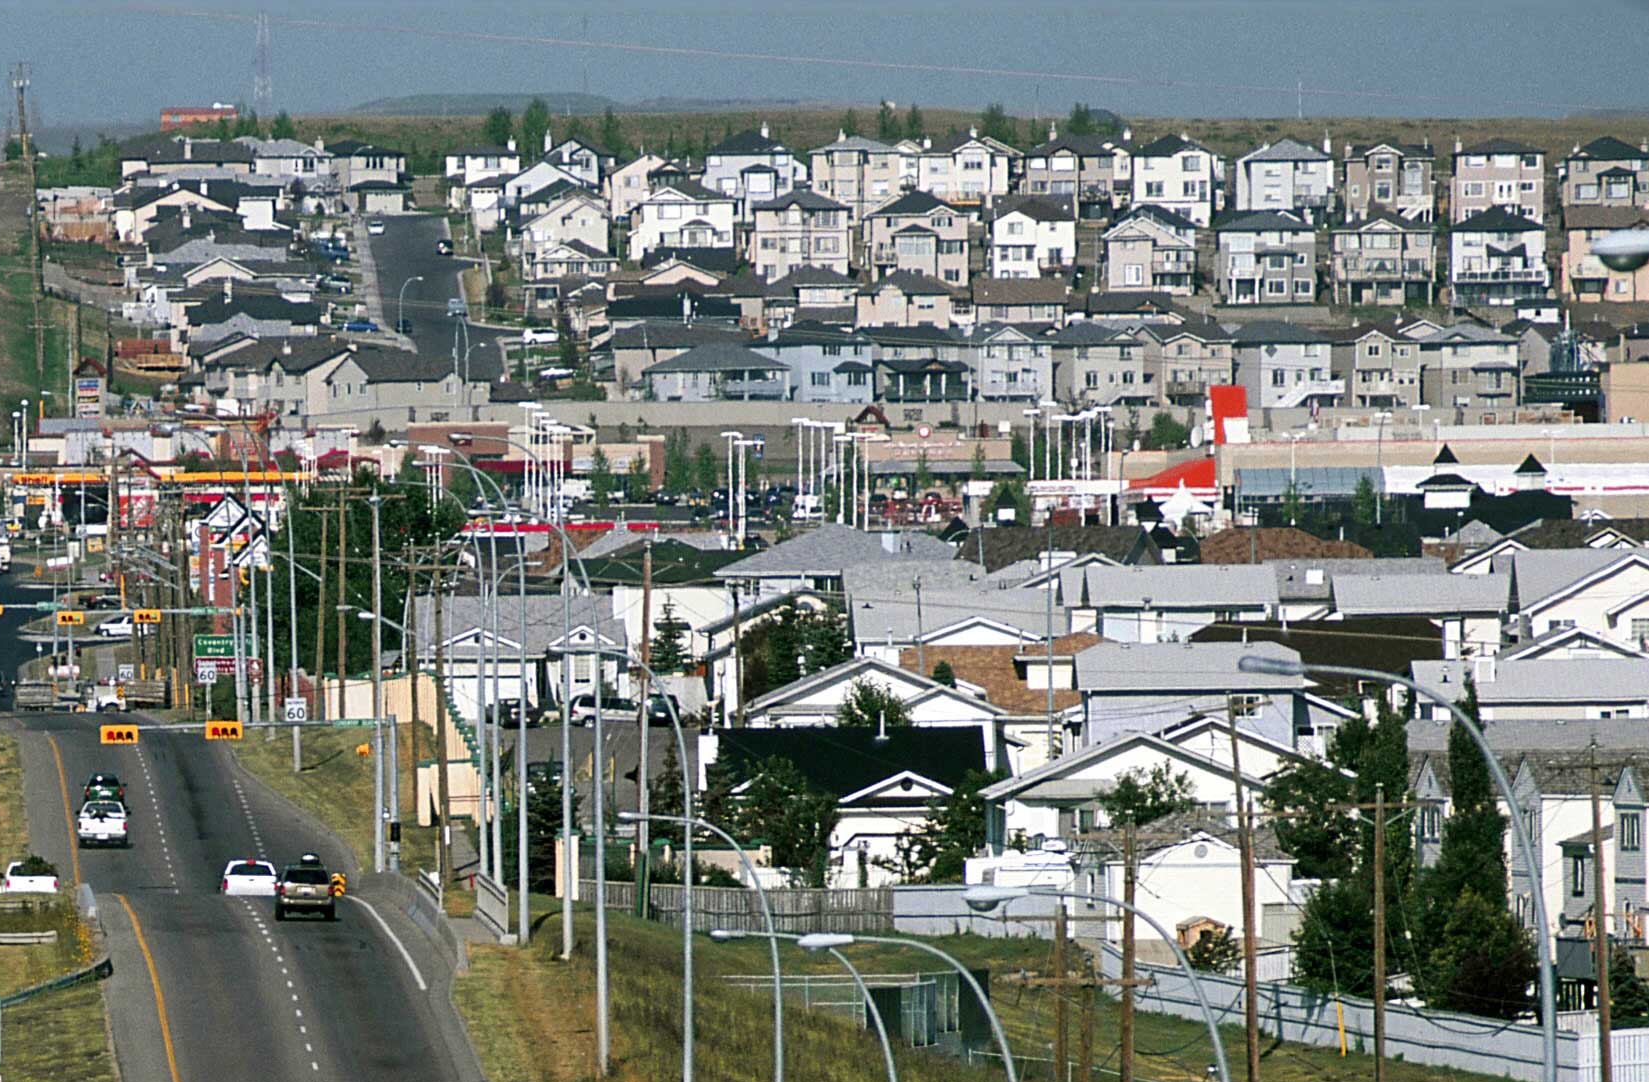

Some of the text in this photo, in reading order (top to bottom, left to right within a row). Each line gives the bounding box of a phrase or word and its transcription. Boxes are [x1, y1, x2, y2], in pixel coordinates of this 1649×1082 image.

[197, 638, 233, 646] Coventry
[199, 671, 215, 680] 60
[287, 707, 305, 719] 60
